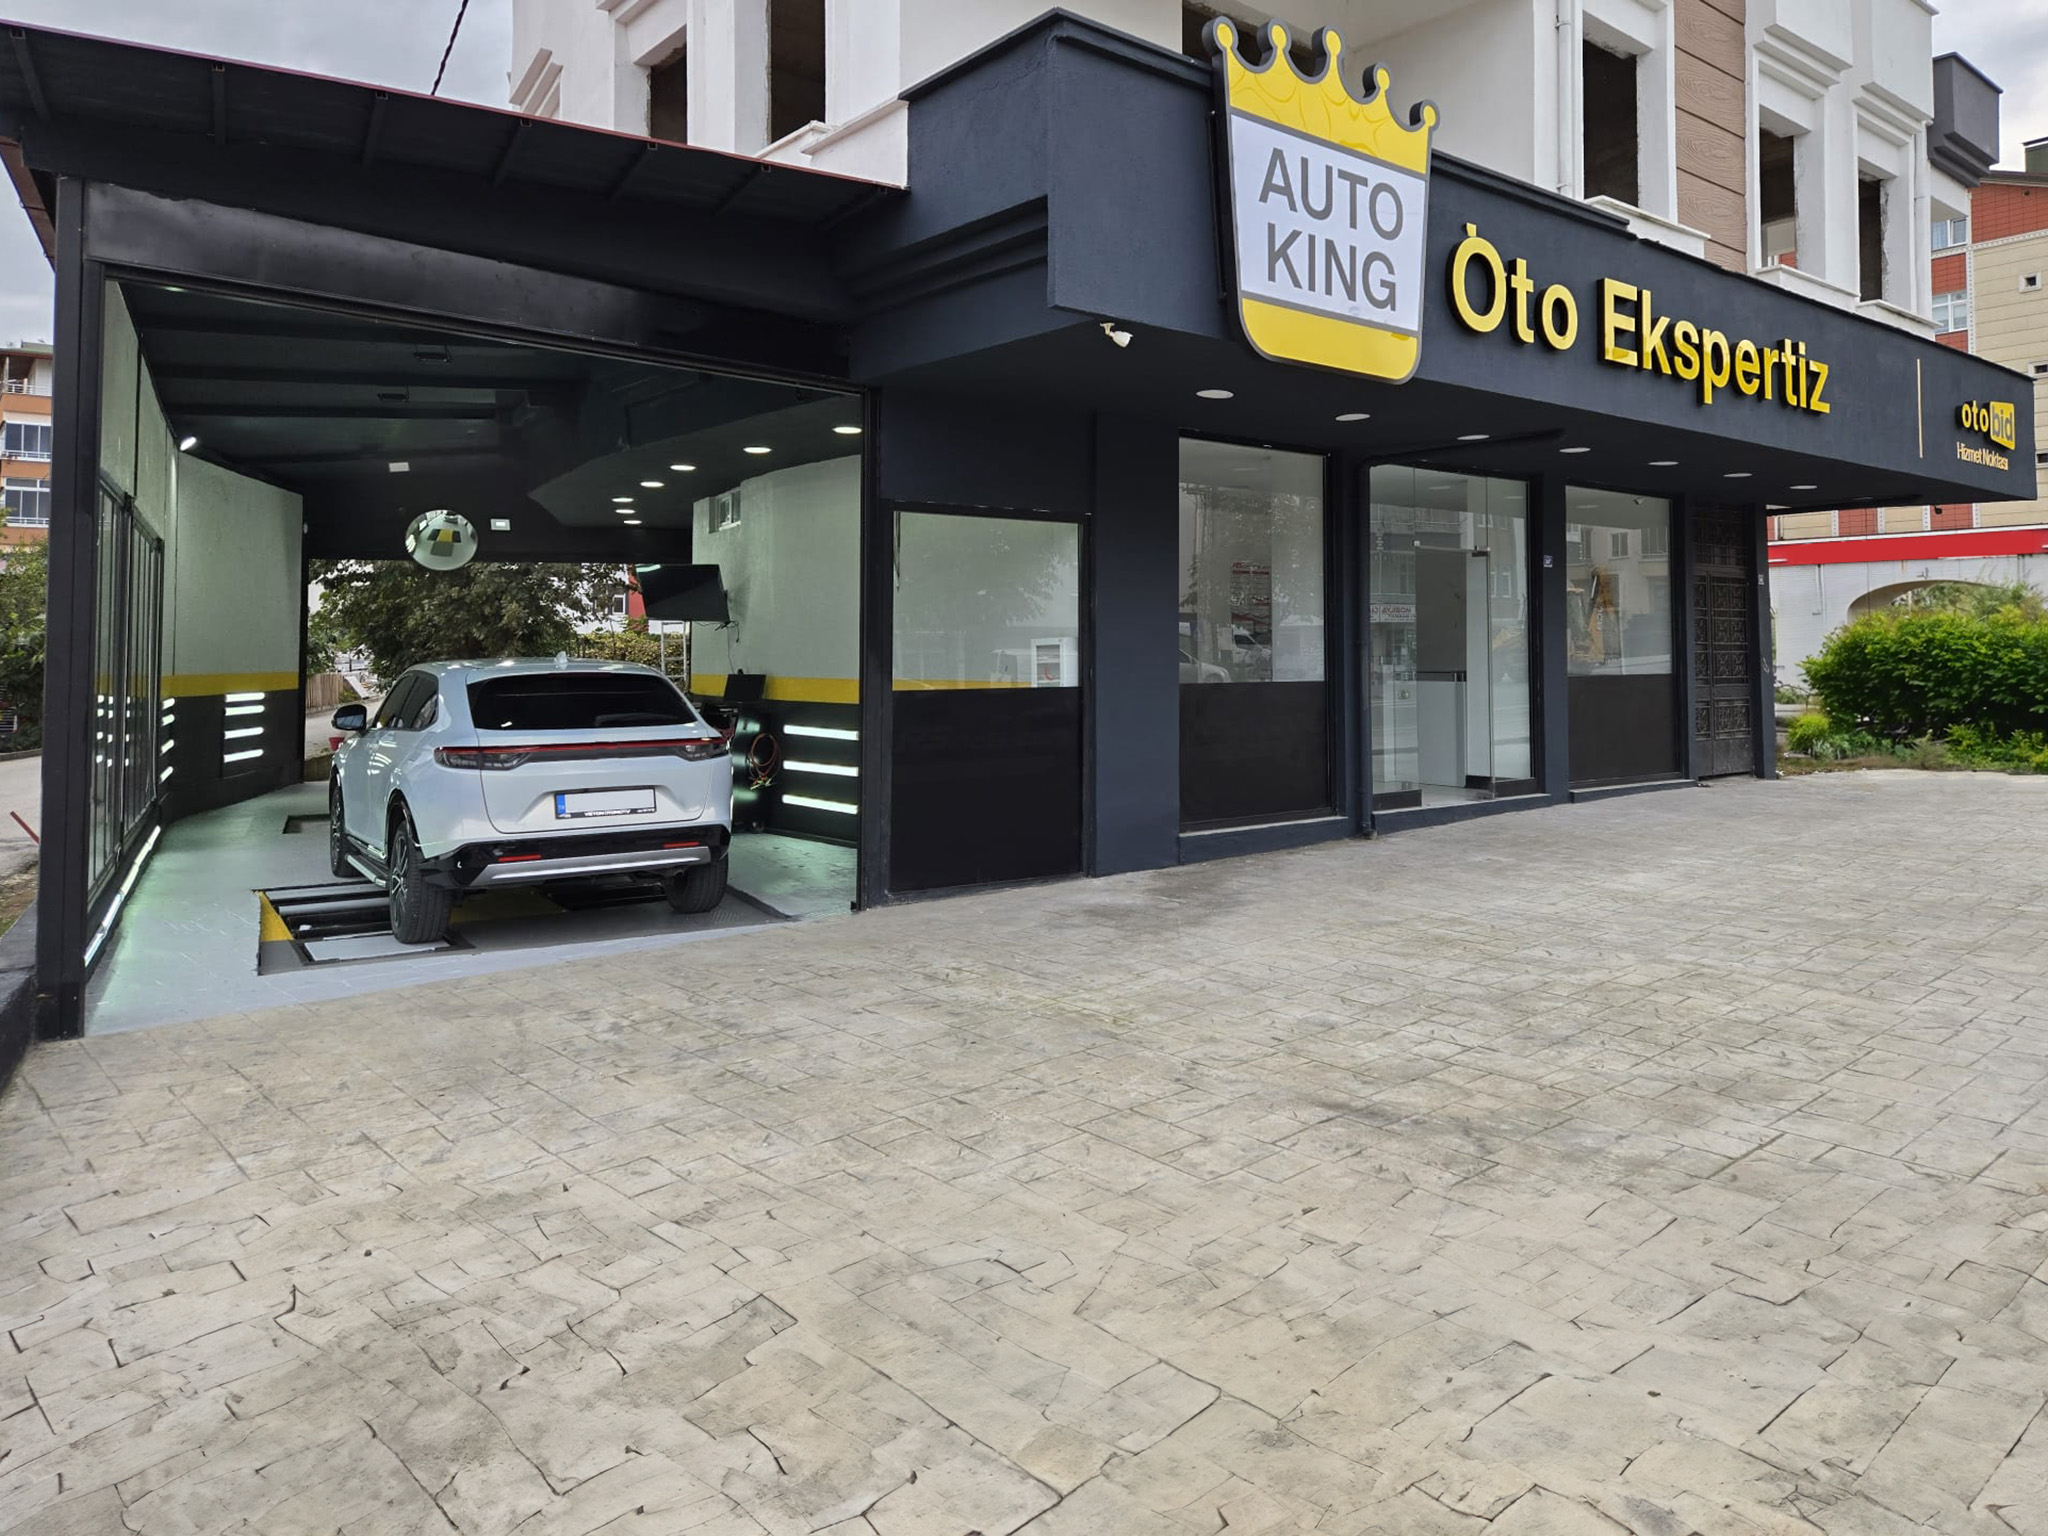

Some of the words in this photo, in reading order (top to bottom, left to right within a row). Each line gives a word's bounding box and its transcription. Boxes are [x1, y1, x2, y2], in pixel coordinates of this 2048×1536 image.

[1259, 147, 1403, 240] AUTO
[1267, 222, 1396, 311] KING
[1604, 277, 1830, 413] Ekspertiz
[1956, 441, 1982, 465] Hizmet
